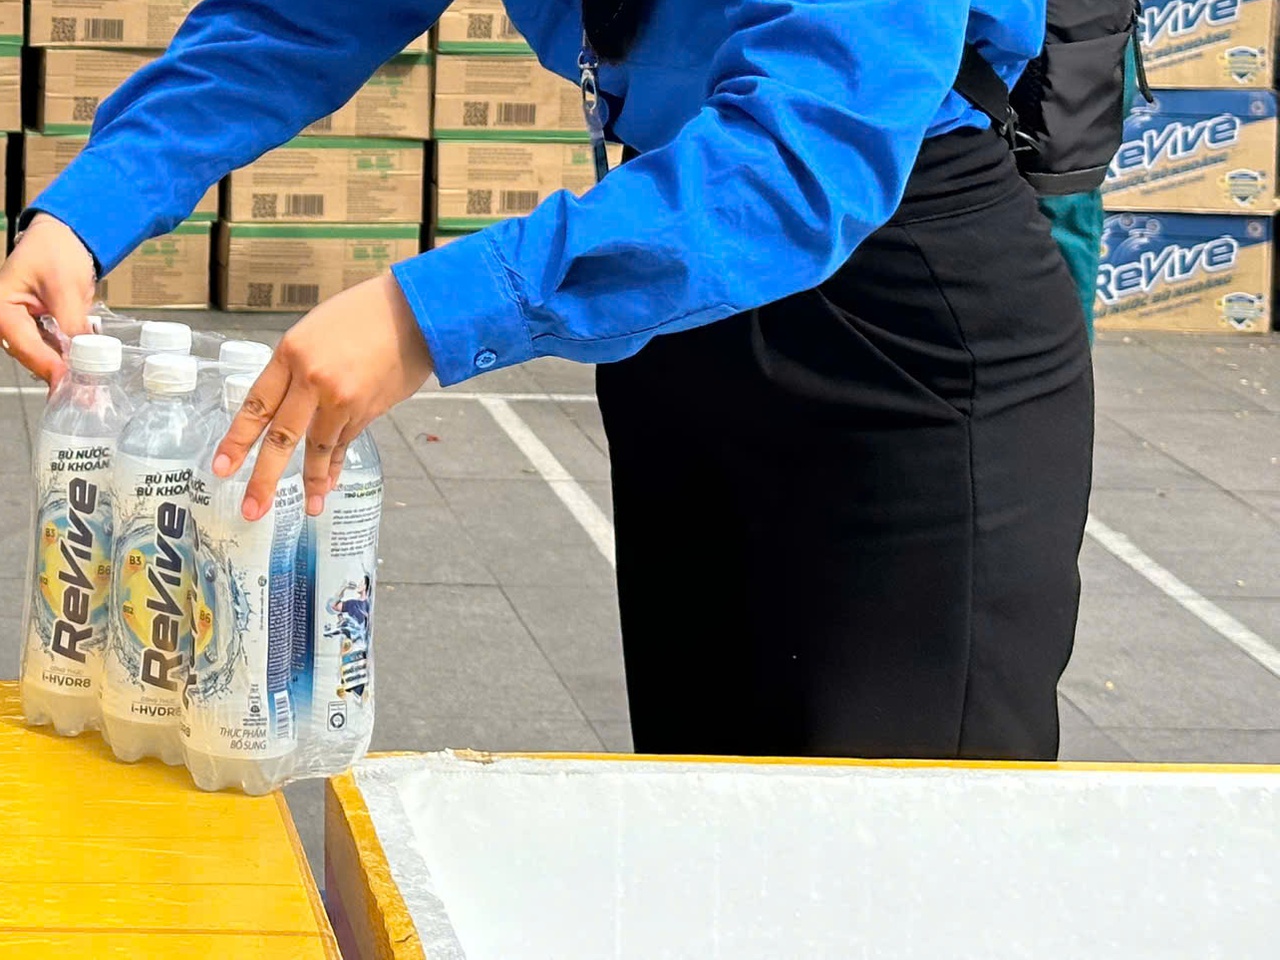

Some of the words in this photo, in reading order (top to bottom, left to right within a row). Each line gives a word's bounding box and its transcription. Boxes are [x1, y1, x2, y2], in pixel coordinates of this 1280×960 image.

[1106, 114, 1240, 180] eVive
[58, 448, 73, 460] BÙ
[75, 446, 110, 459] NƯỚC
[51, 460, 67, 471] BÙ
[68, 458, 110, 471] KHOÁN
[145, 471, 162, 484] BÙ
[165, 468, 192, 483] NƯỚ
[137, 485, 154, 496] BÙ
[156, 483, 191, 496] KHOÁ
[45, 528, 55, 538] B3
[129, 555, 141, 565] B3
[51, 476, 98, 664] ReVive
[141, 501, 187, 692] ReVive
[199, 610, 211, 624] B6
[244, 740, 266, 750] SUNG
